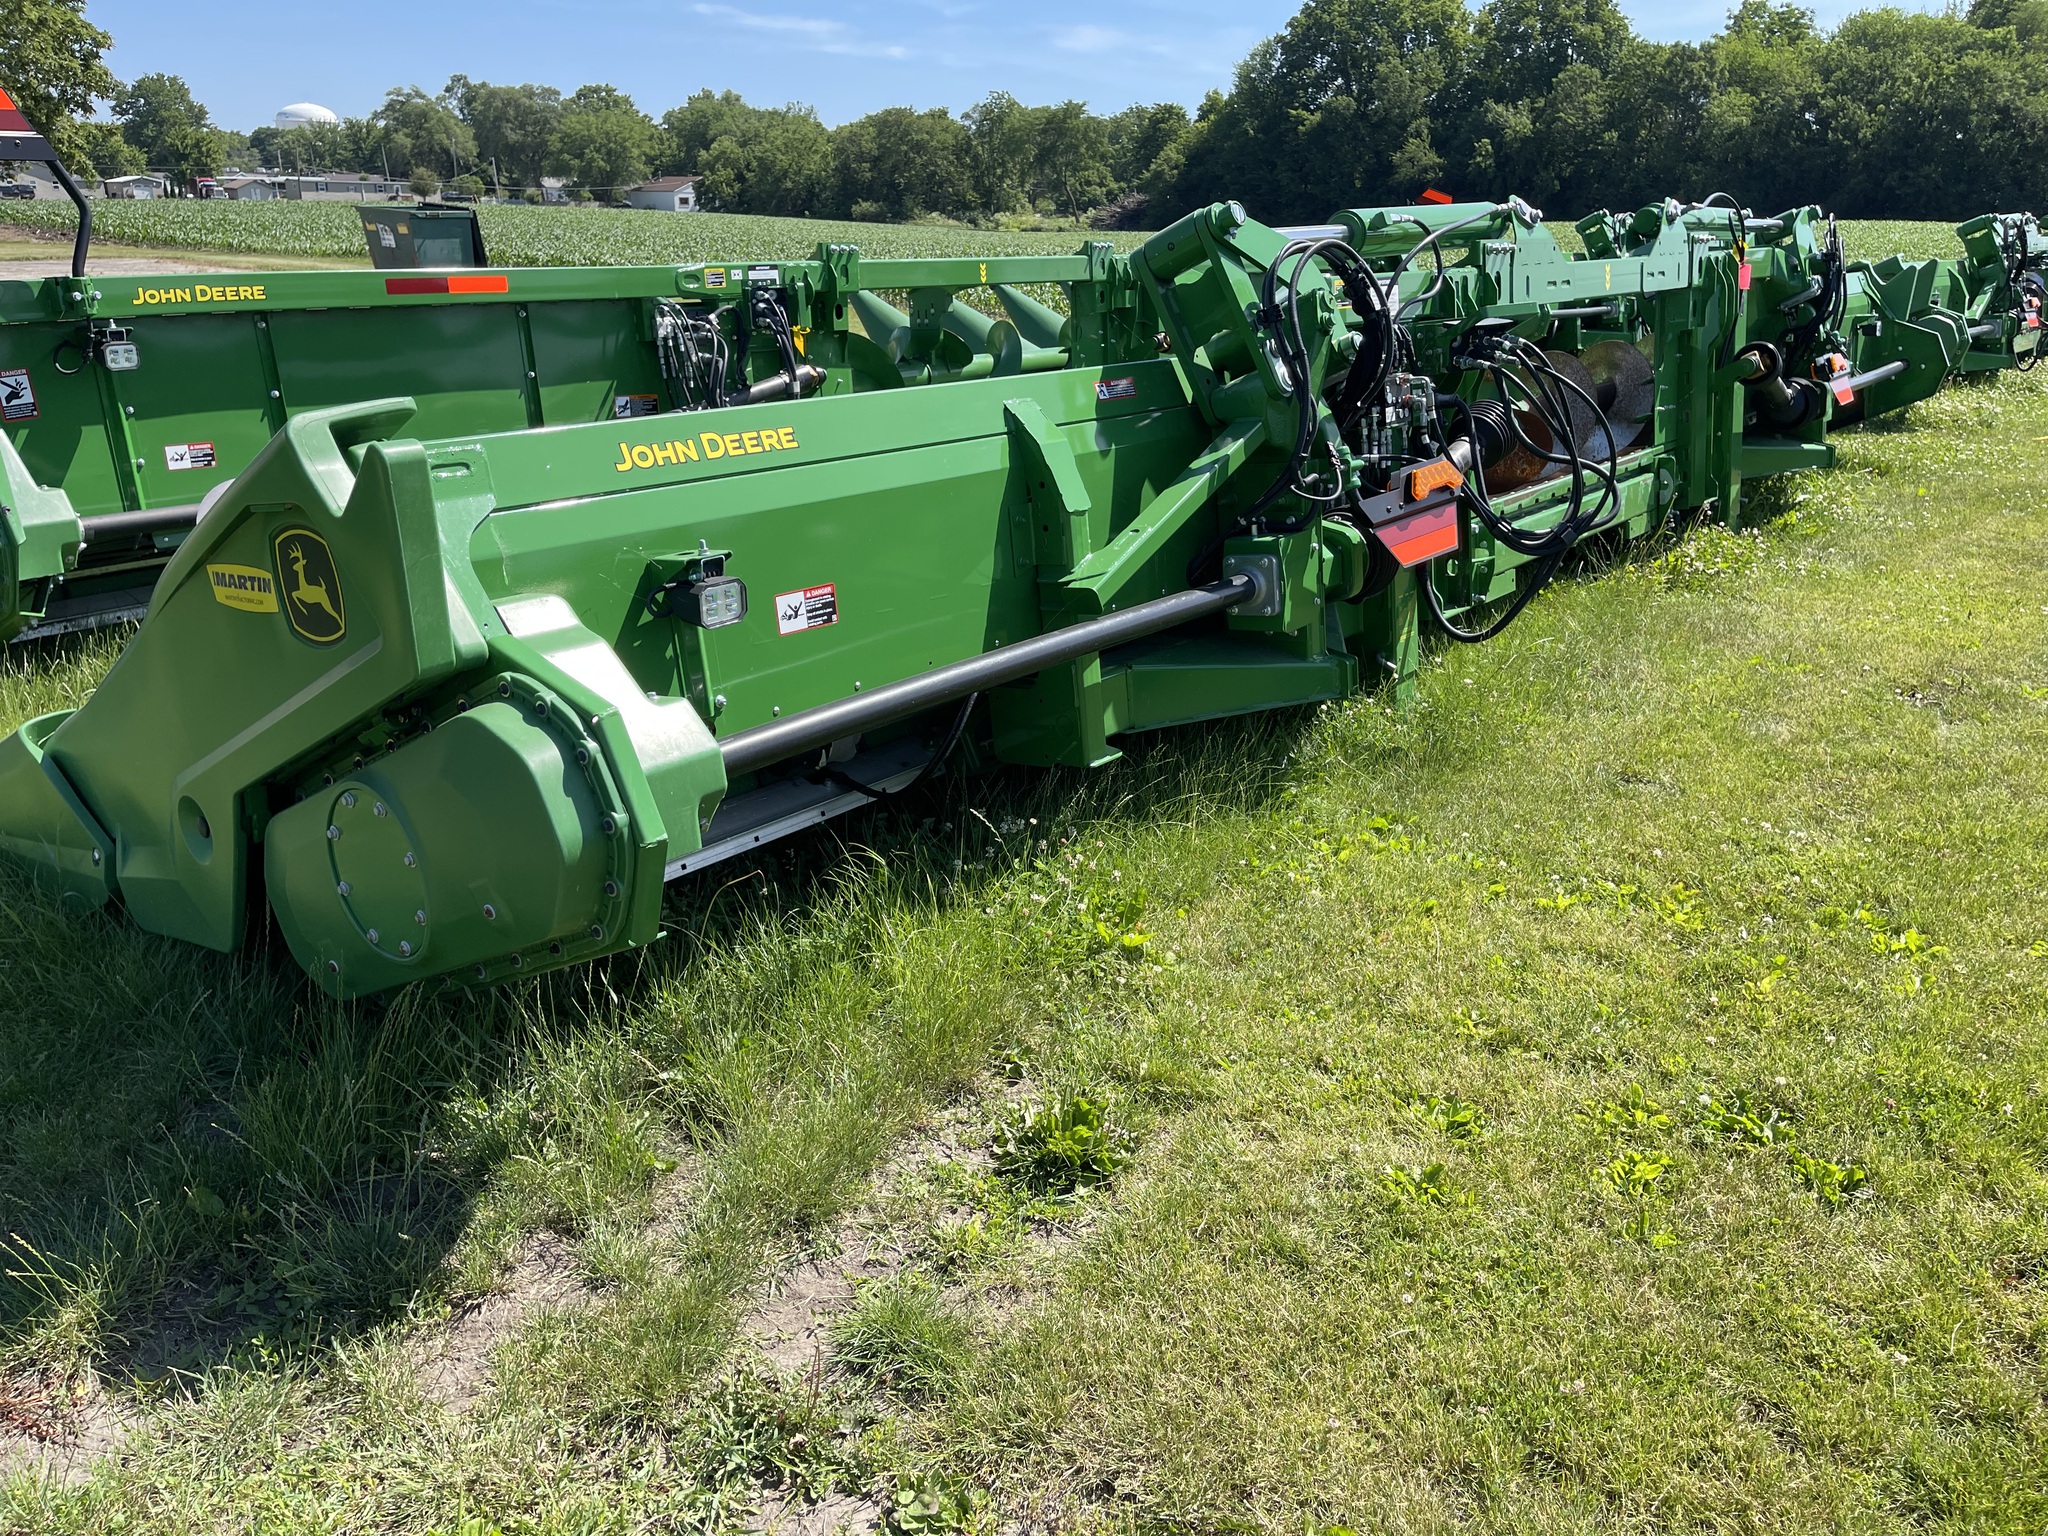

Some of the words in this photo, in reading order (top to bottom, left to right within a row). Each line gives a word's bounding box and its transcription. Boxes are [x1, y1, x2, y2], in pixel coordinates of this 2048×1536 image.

[132, 286, 192, 305] JOHN
[194, 284, 267, 302] DEERE
[1, 369, 27, 377] DANGER
[615, 439, 700, 473] JOHN
[698, 426, 800, 461] DEERE
[212, 571, 272, 595] MARTIN
[811, 586, 832, 596] DANGER
